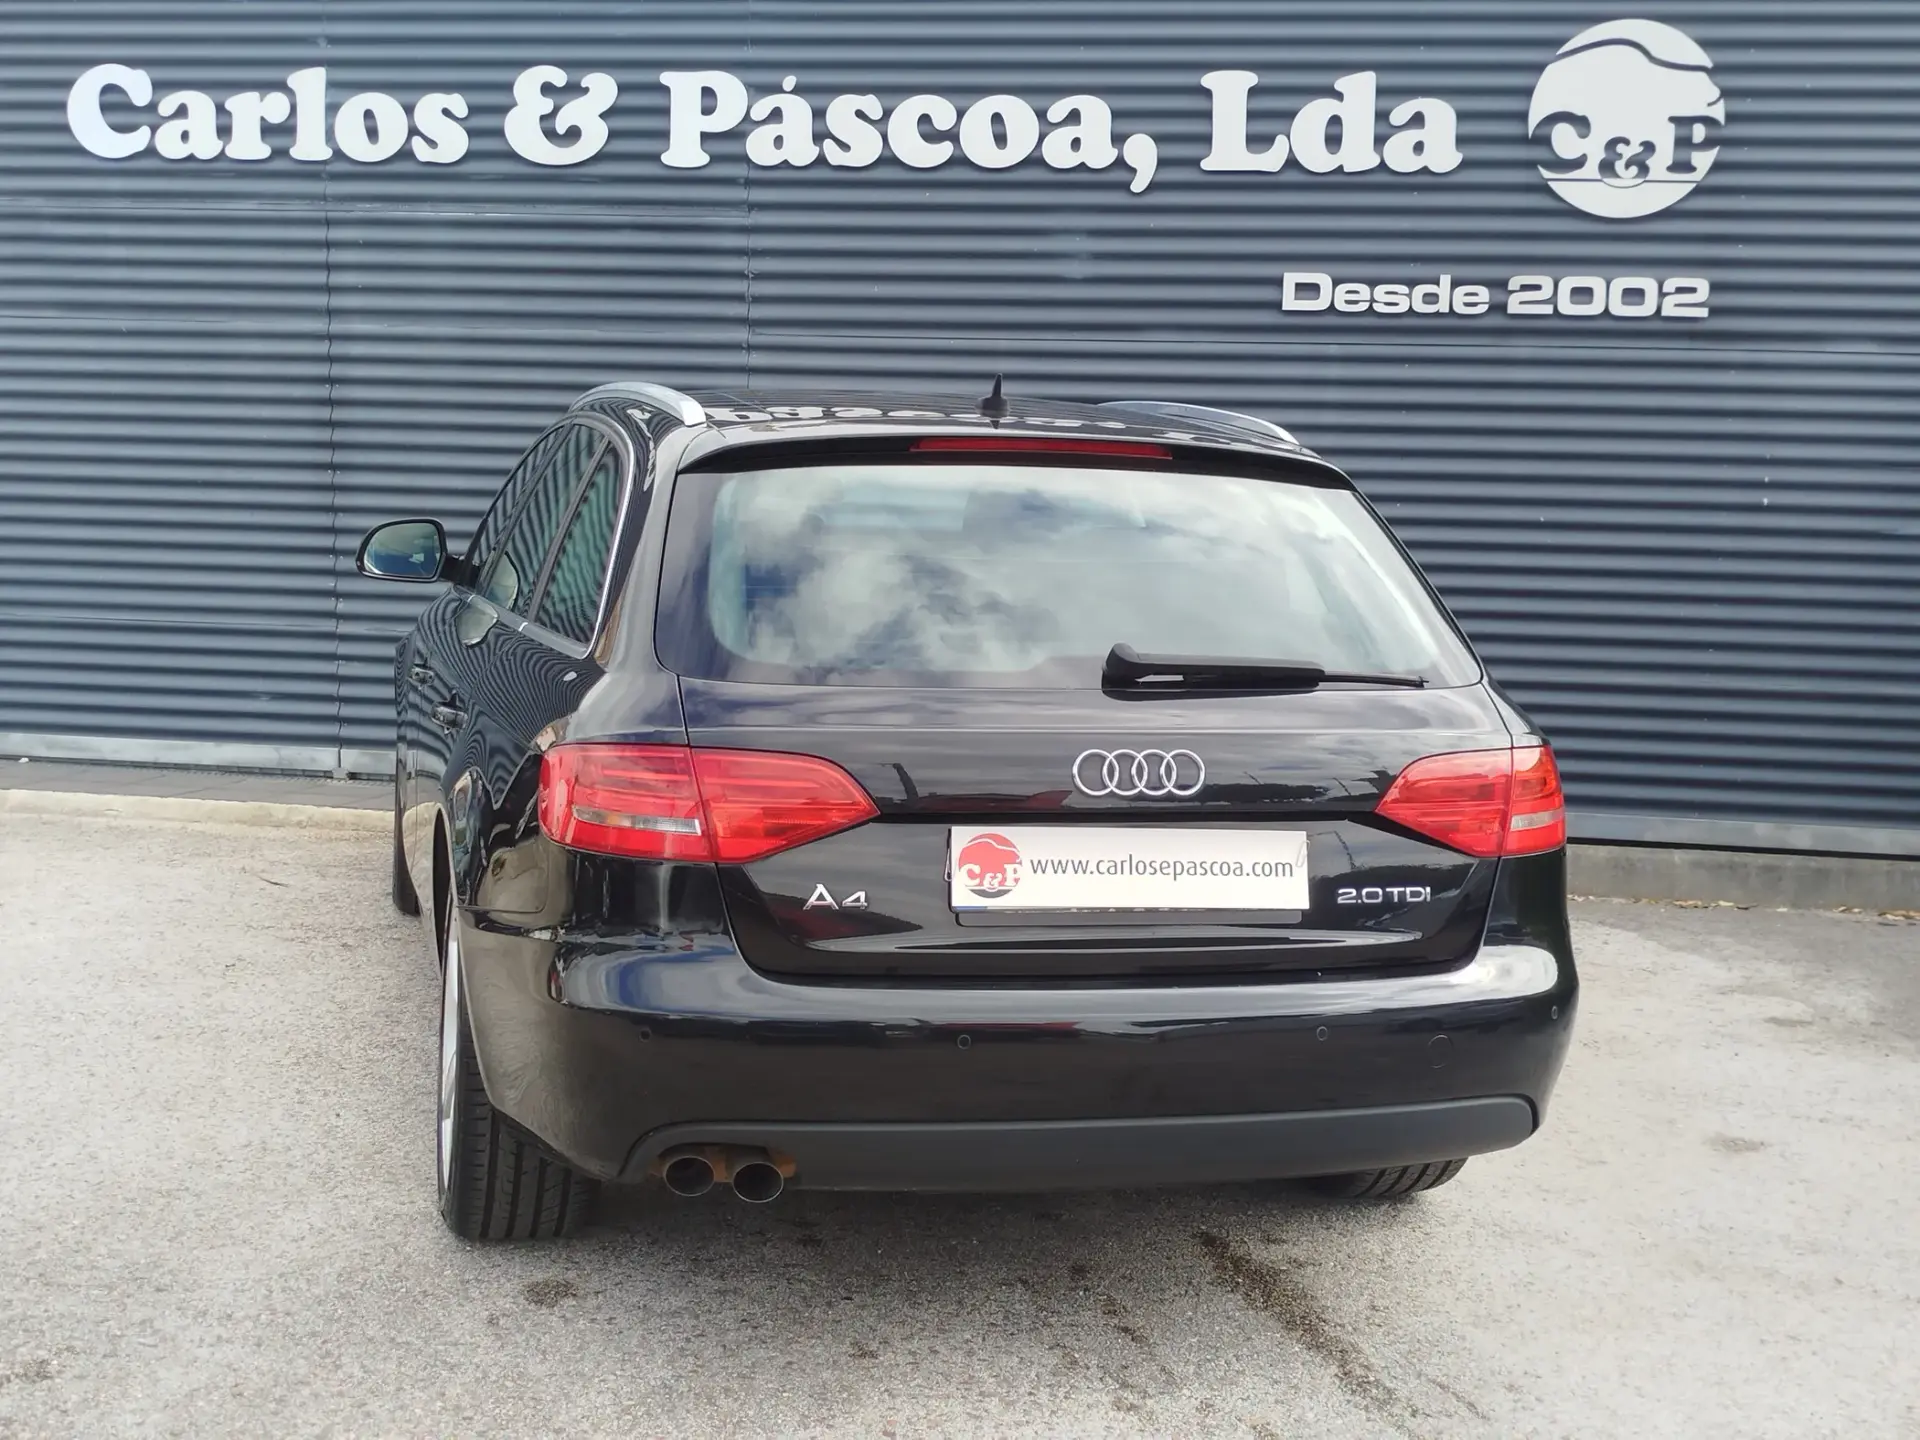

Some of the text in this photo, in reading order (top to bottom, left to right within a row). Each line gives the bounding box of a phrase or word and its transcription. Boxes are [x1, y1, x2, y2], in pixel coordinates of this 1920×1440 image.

[67, 63, 1463, 193] Carlos & Páscoa, Lda
[1282, 272, 1710, 317] Desde 2002
[1030, 854, 1293, 881] www.carlosepascoa.com
[803, 883, 868, 910] A4
